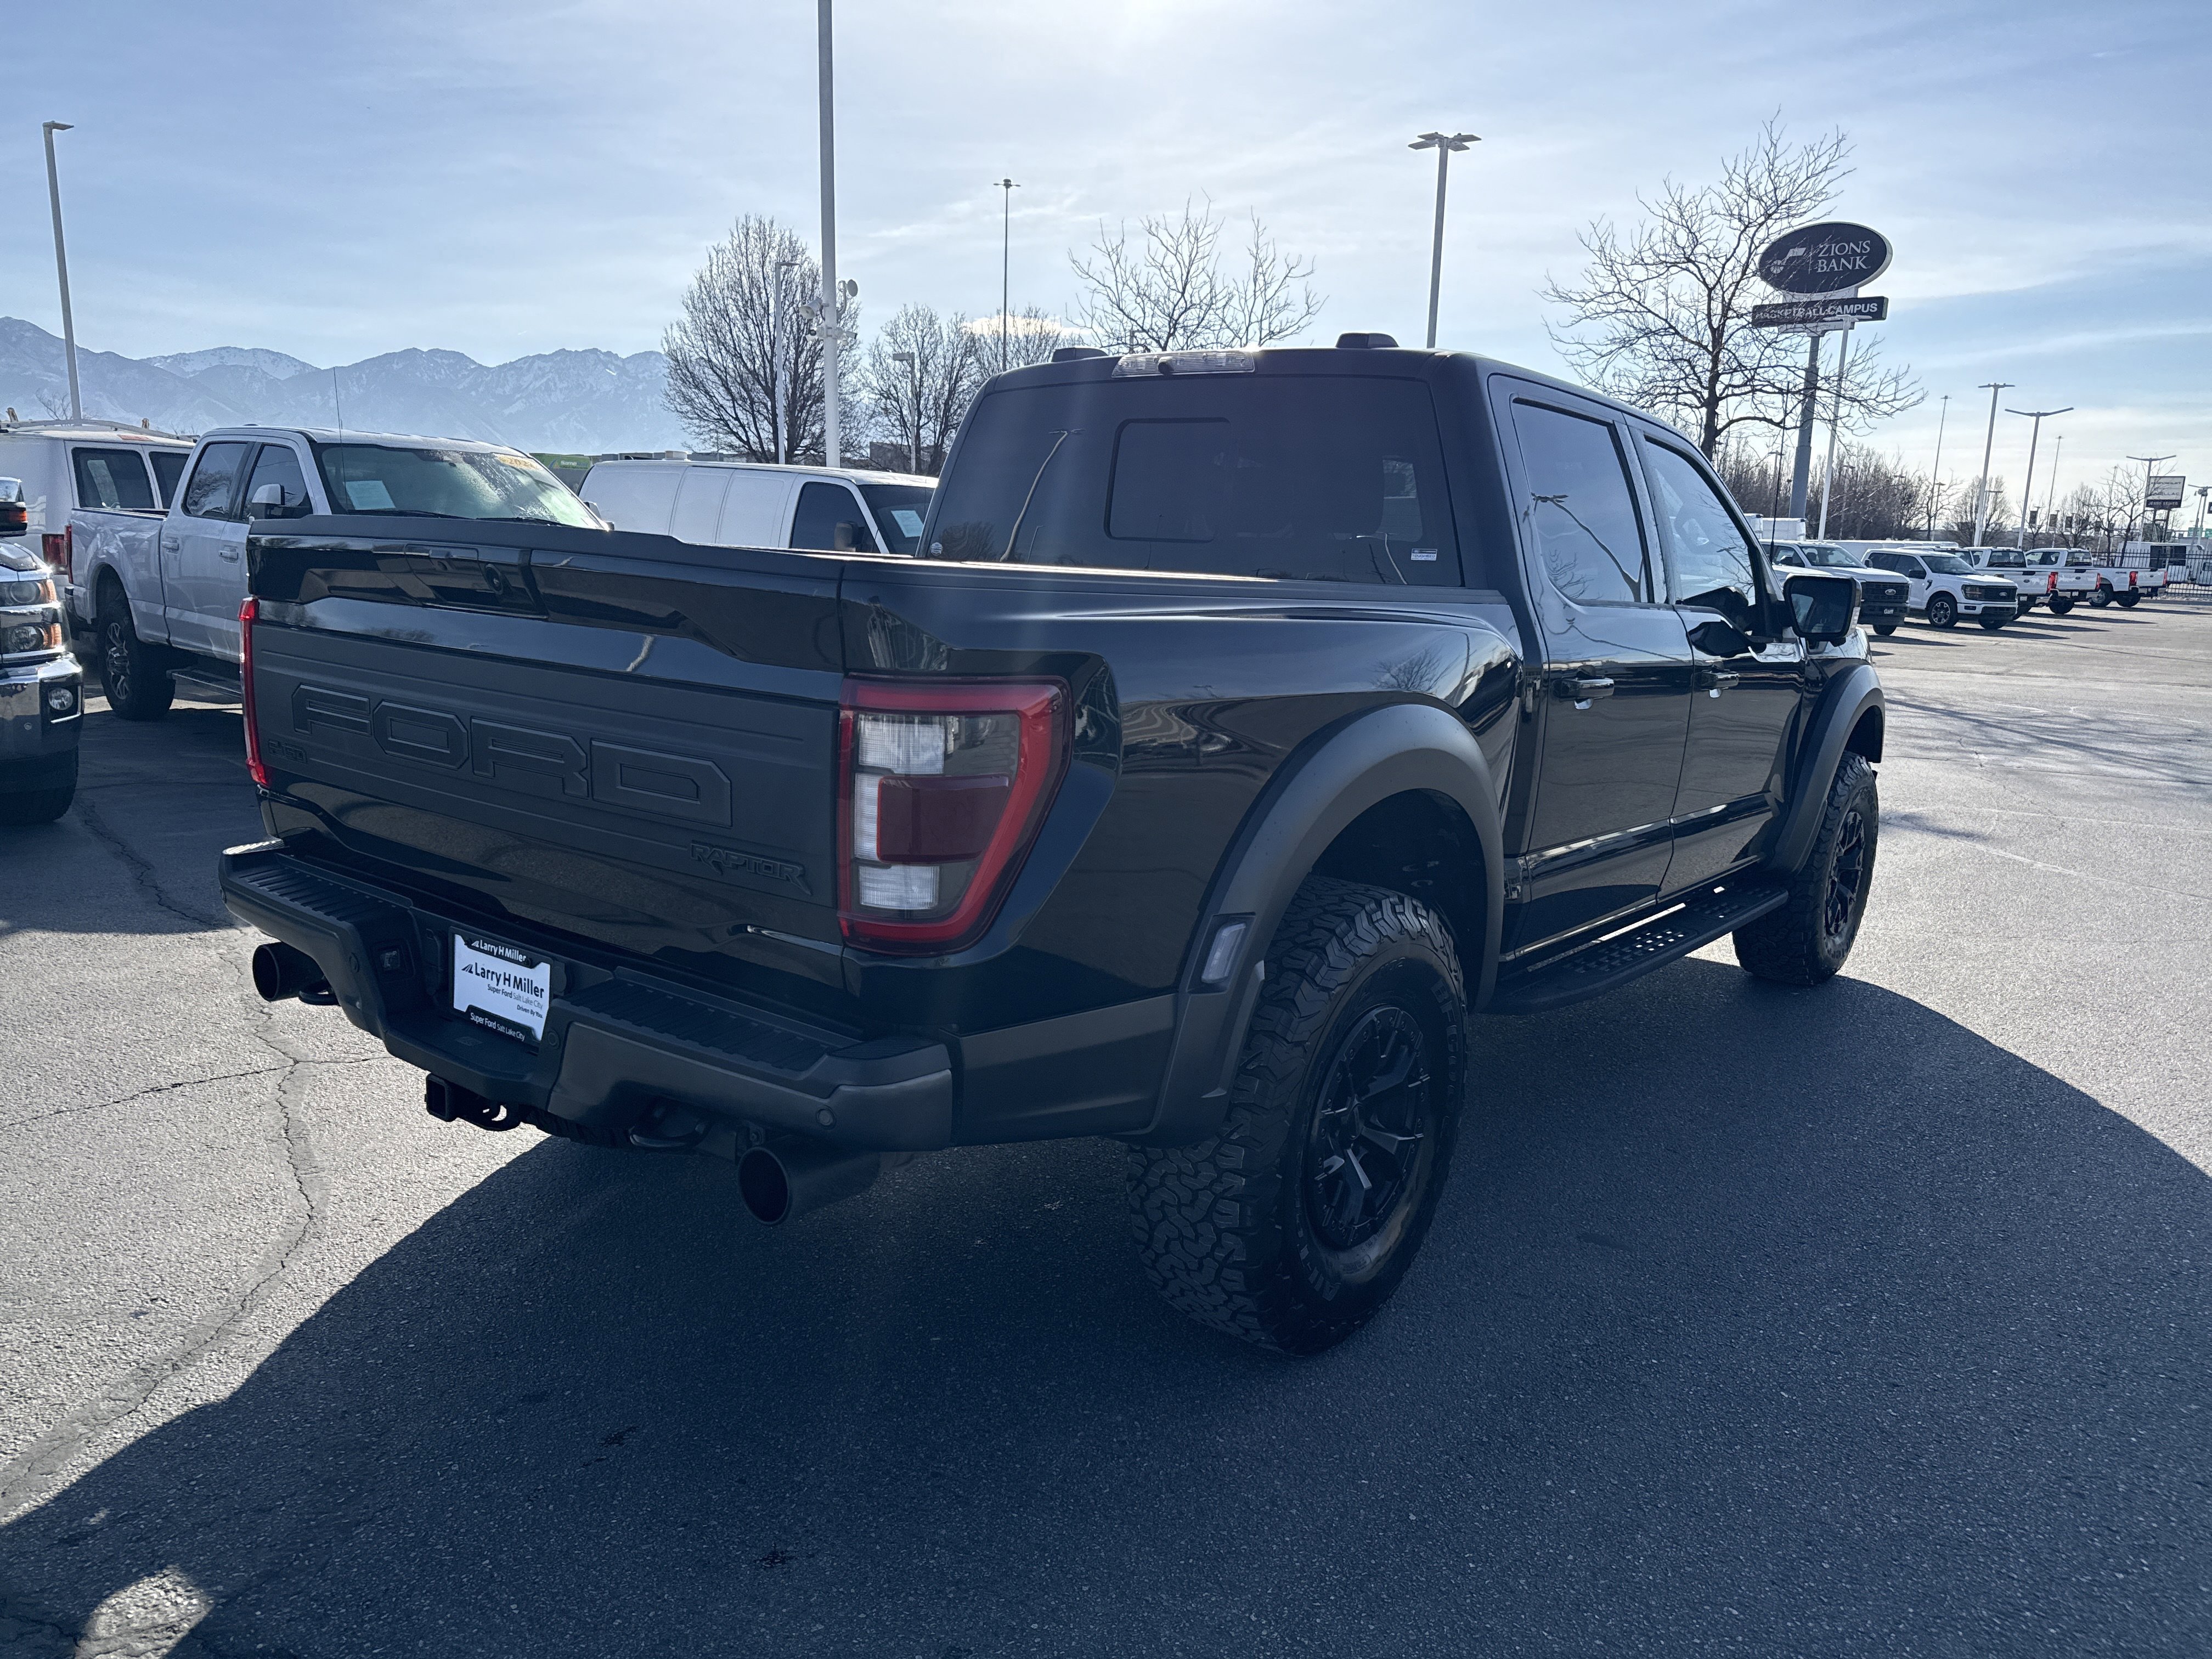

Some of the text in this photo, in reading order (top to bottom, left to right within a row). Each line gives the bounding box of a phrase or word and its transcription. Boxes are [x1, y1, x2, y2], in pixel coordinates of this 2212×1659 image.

[1818, 240, 1871, 257] ZIONS
[1816, 255, 1868, 273] BANK
[1826, 303, 1878, 316] CAMPUS
[291, 684, 732, 828] FORD
[690, 841, 812, 896] RAPTOR
[479, 940, 527, 962] Larry H Miller
[475, 962, 545, 998] Larry H Miller
[487, 984, 543, 1010] Super Ford Salt Lake City
[470, 1012, 526, 1042] Super Ford Salt Lake City
